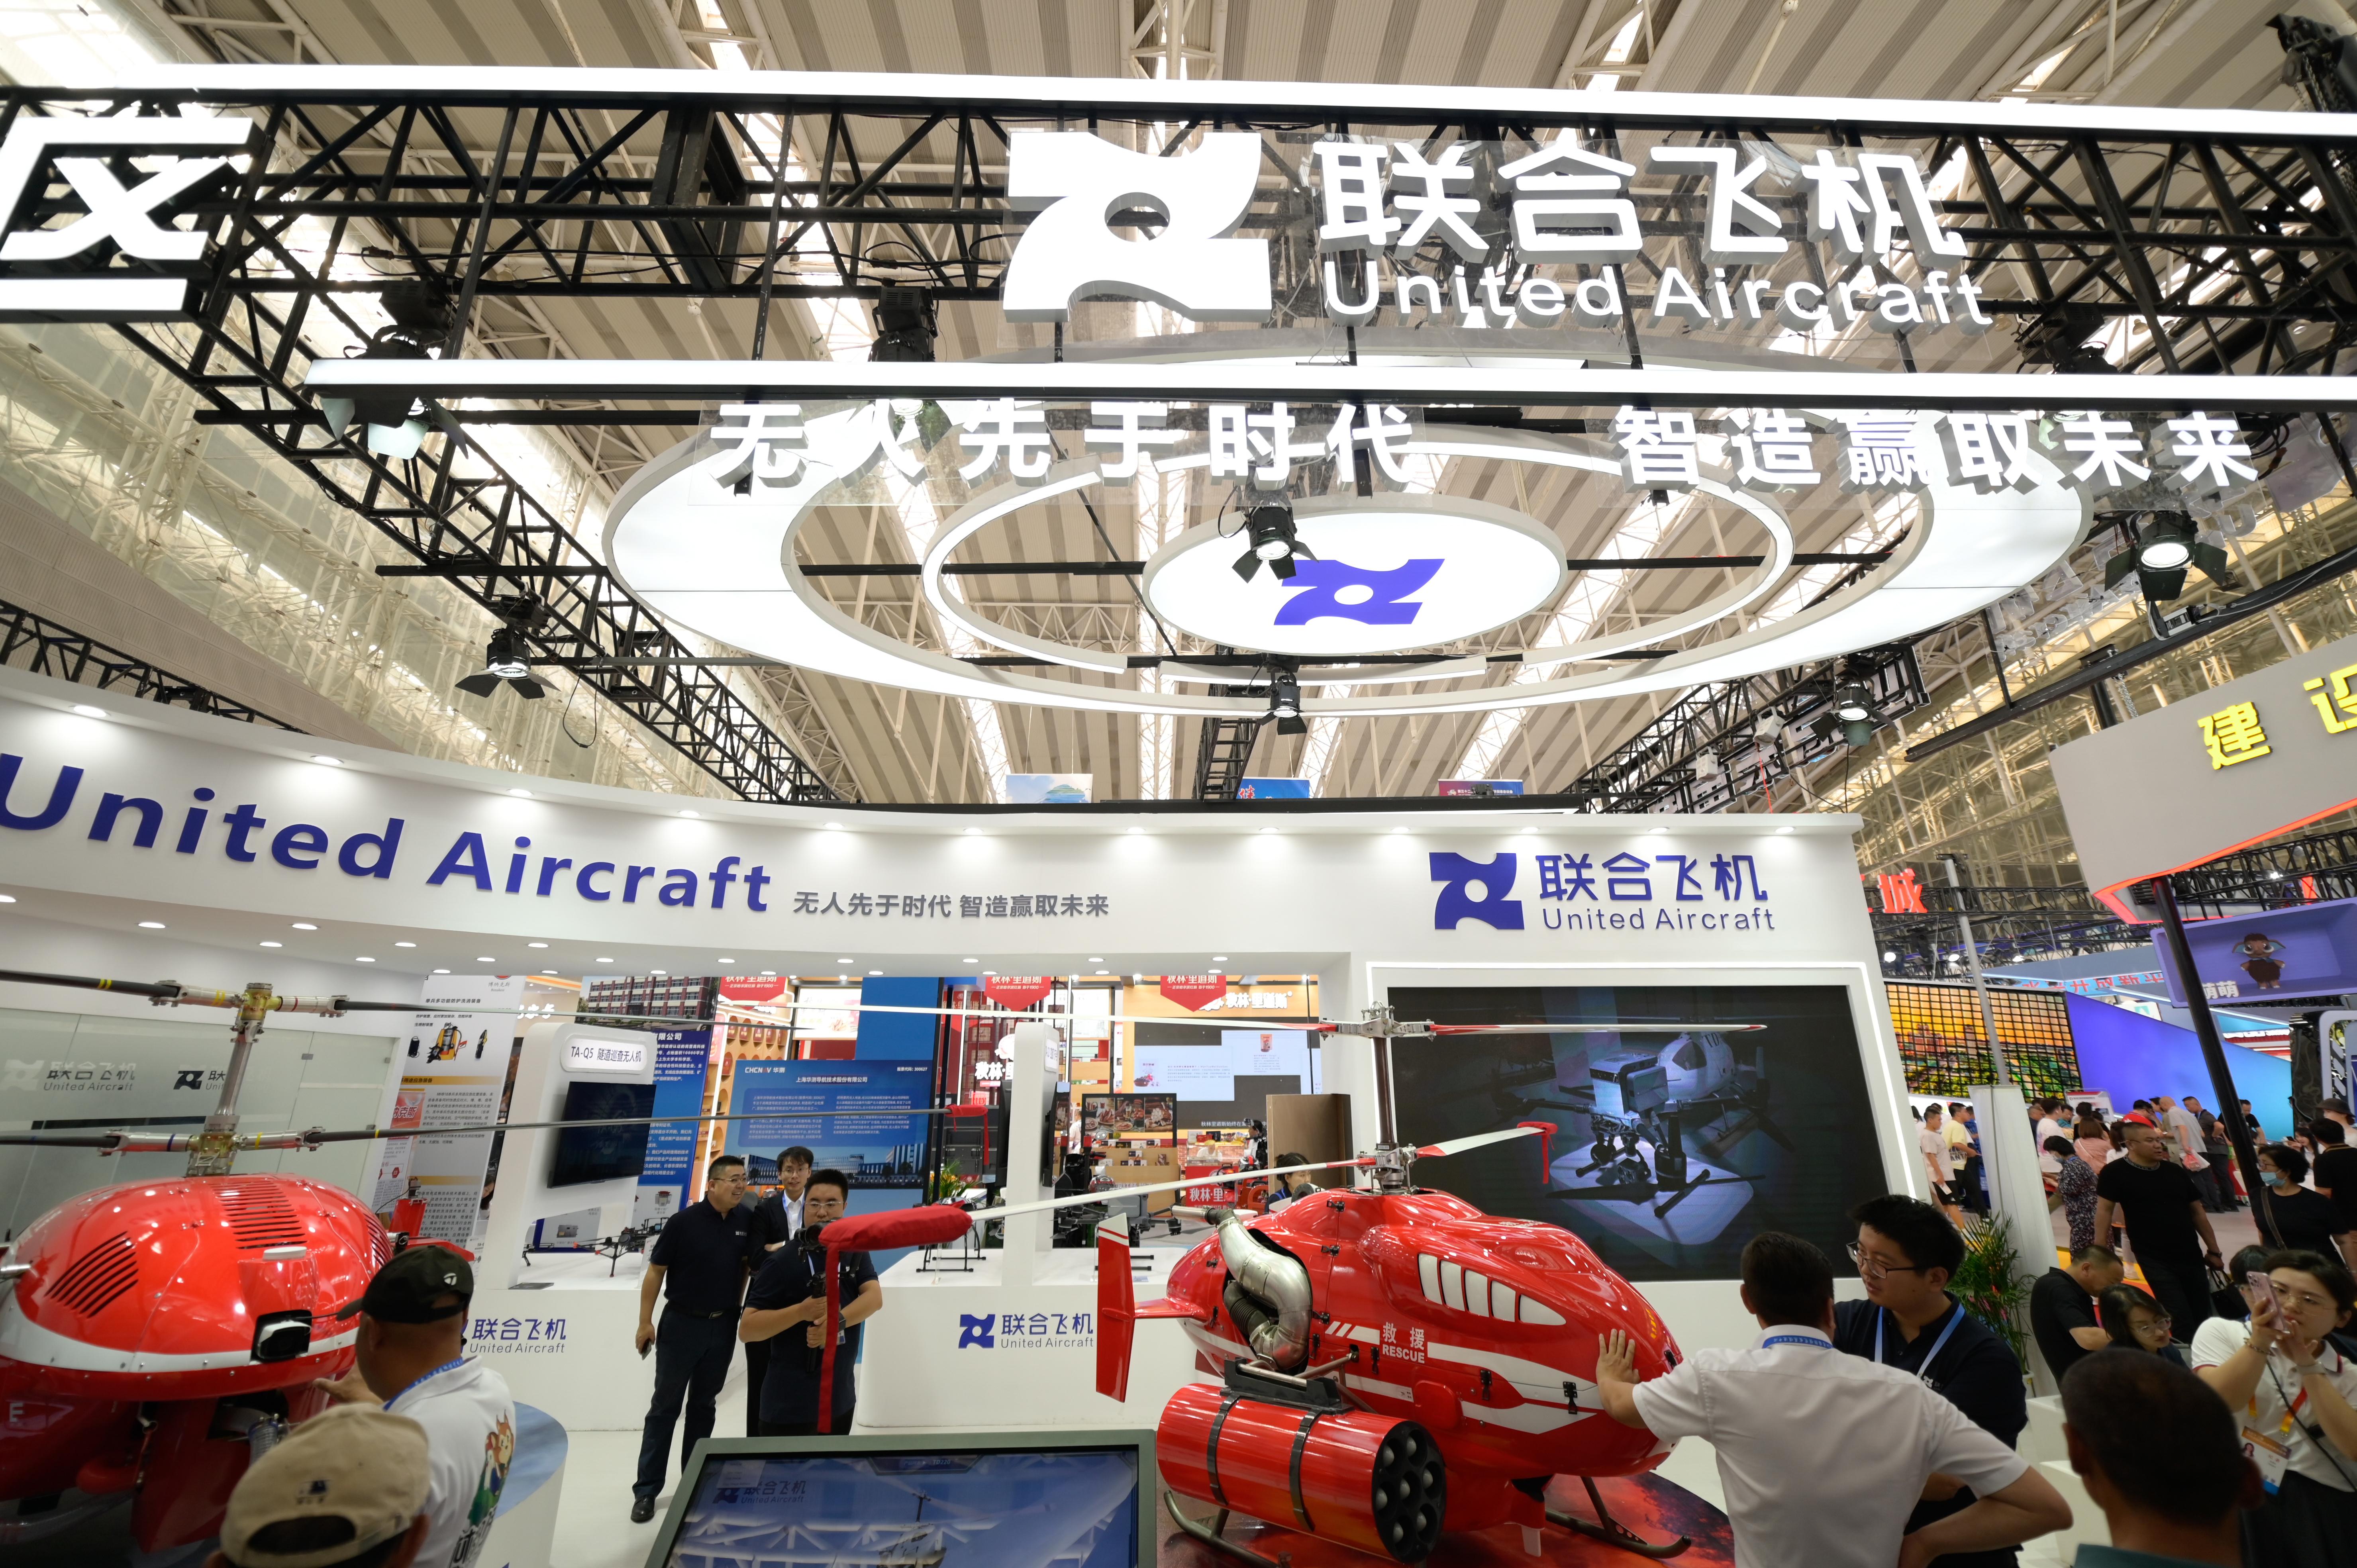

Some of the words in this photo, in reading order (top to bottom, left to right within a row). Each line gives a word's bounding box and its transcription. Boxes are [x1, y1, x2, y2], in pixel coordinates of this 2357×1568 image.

[1311, 141, 1967, 261] 联合飞机
[1324, 260, 1623, 321] United
[1653, 266, 1993, 327] Aircraft
[710, 399, 1415, 488] 无人先于时代
[1610, 406, 2259, 495] 智造赢取未来
[0, 753, 405, 879] United
[425, 831, 771, 912] Aircraft
[793, 891, 952, 918] 无人先于时代
[959, 894, 1110, 918] 智造赢取未来
[1535, 852, 1768, 901] 联合飞机
[1861, 868, 1928, 913] 城
[1543, 907, 1644, 930] United
[1656, 907, 1775, 930] Aircraft
[571, 1046, 594, 1059] TA-Q5
[597, 1048, 642, 1062] 隧道巡查无人机
[43, 1082, 86, 1091] United
[87, 1082, 133, 1091] Aircraft
[1189, 1188, 1226, 1198] 秋林·里
[472, 1318, 566, 1340] 联合飞机
[1001, 1313, 1093, 1335] 联合飞机
[1001, 1338, 1042, 1348] United
[1045, 1337, 1094, 1348] Aircraft
[1382, 1322, 1425, 1350] 救援
[470, 1343, 512, 1353] United
[514, 1343, 565, 1353] Aircraft
[1382, 1344, 1425, 1364] RESCUE
